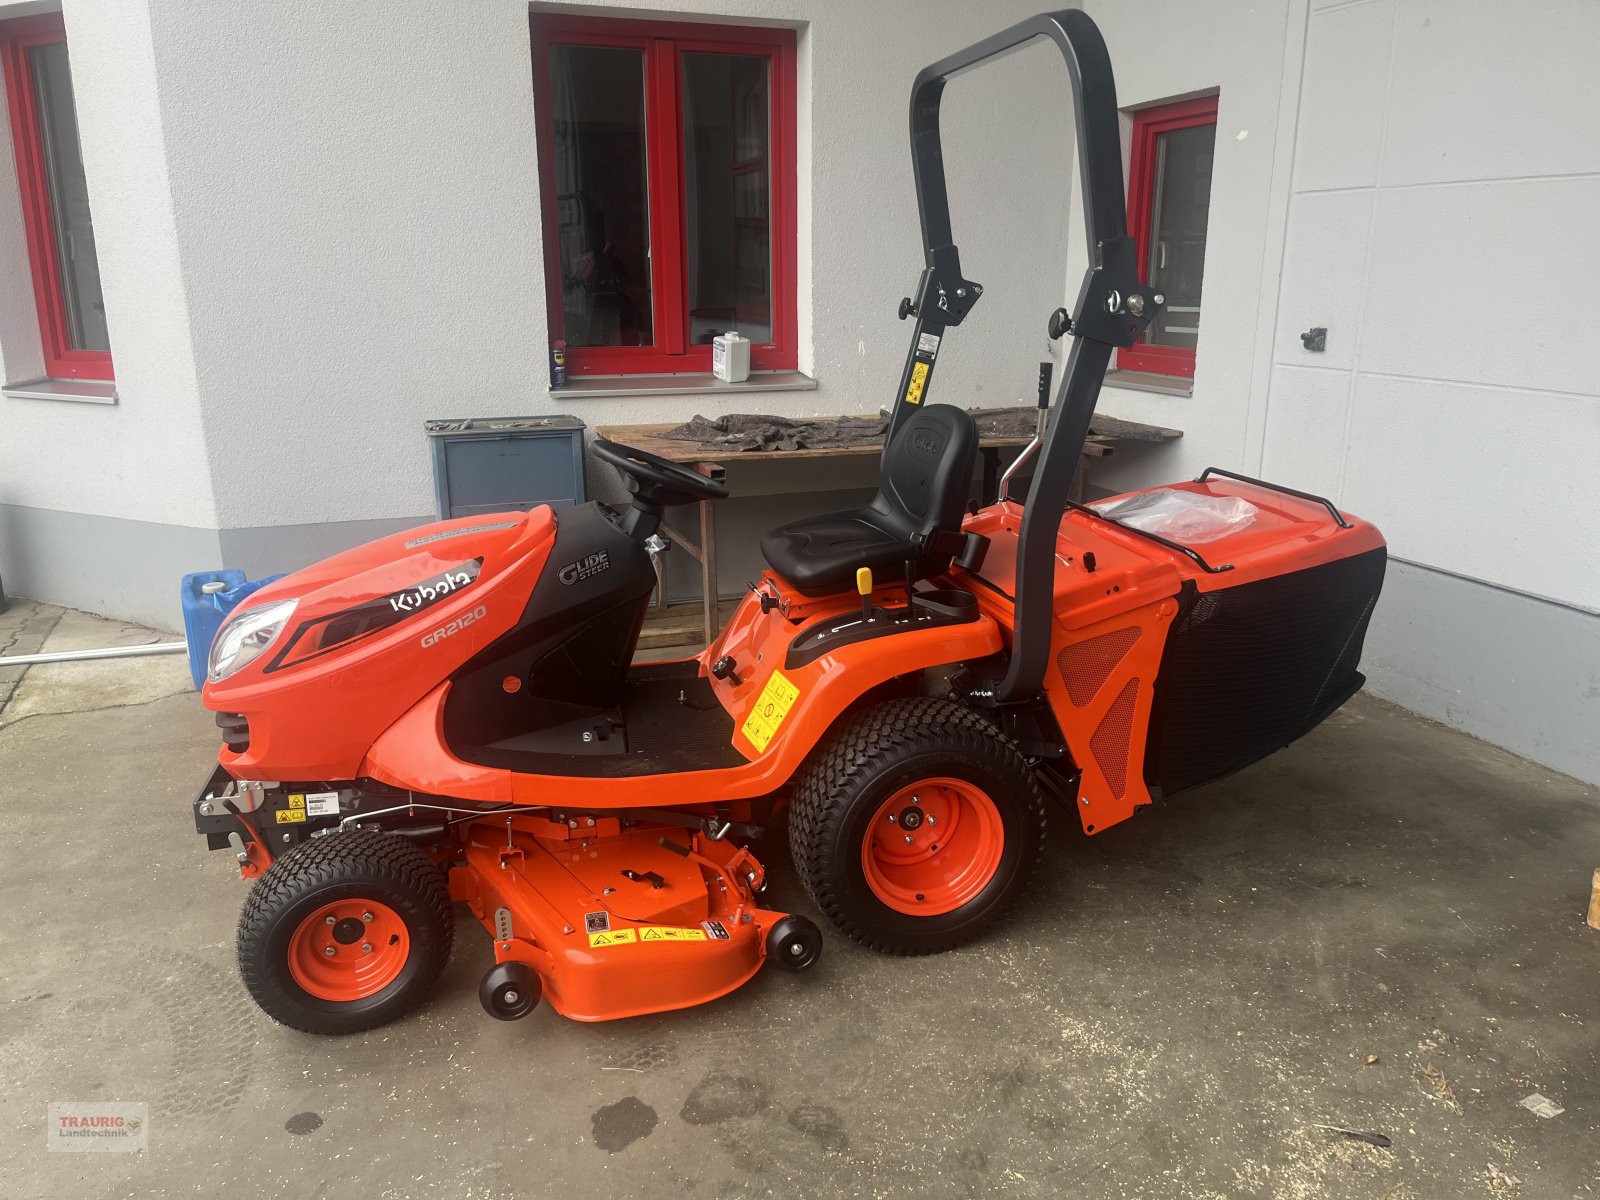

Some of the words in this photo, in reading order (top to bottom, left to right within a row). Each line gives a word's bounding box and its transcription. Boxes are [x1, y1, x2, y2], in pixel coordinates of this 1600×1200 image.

[558, 549, 608, 586] GLIDE
[579, 561, 610, 580] STEER
[389, 572, 471, 612] Kubota
[420, 604, 487, 649] GR2120
